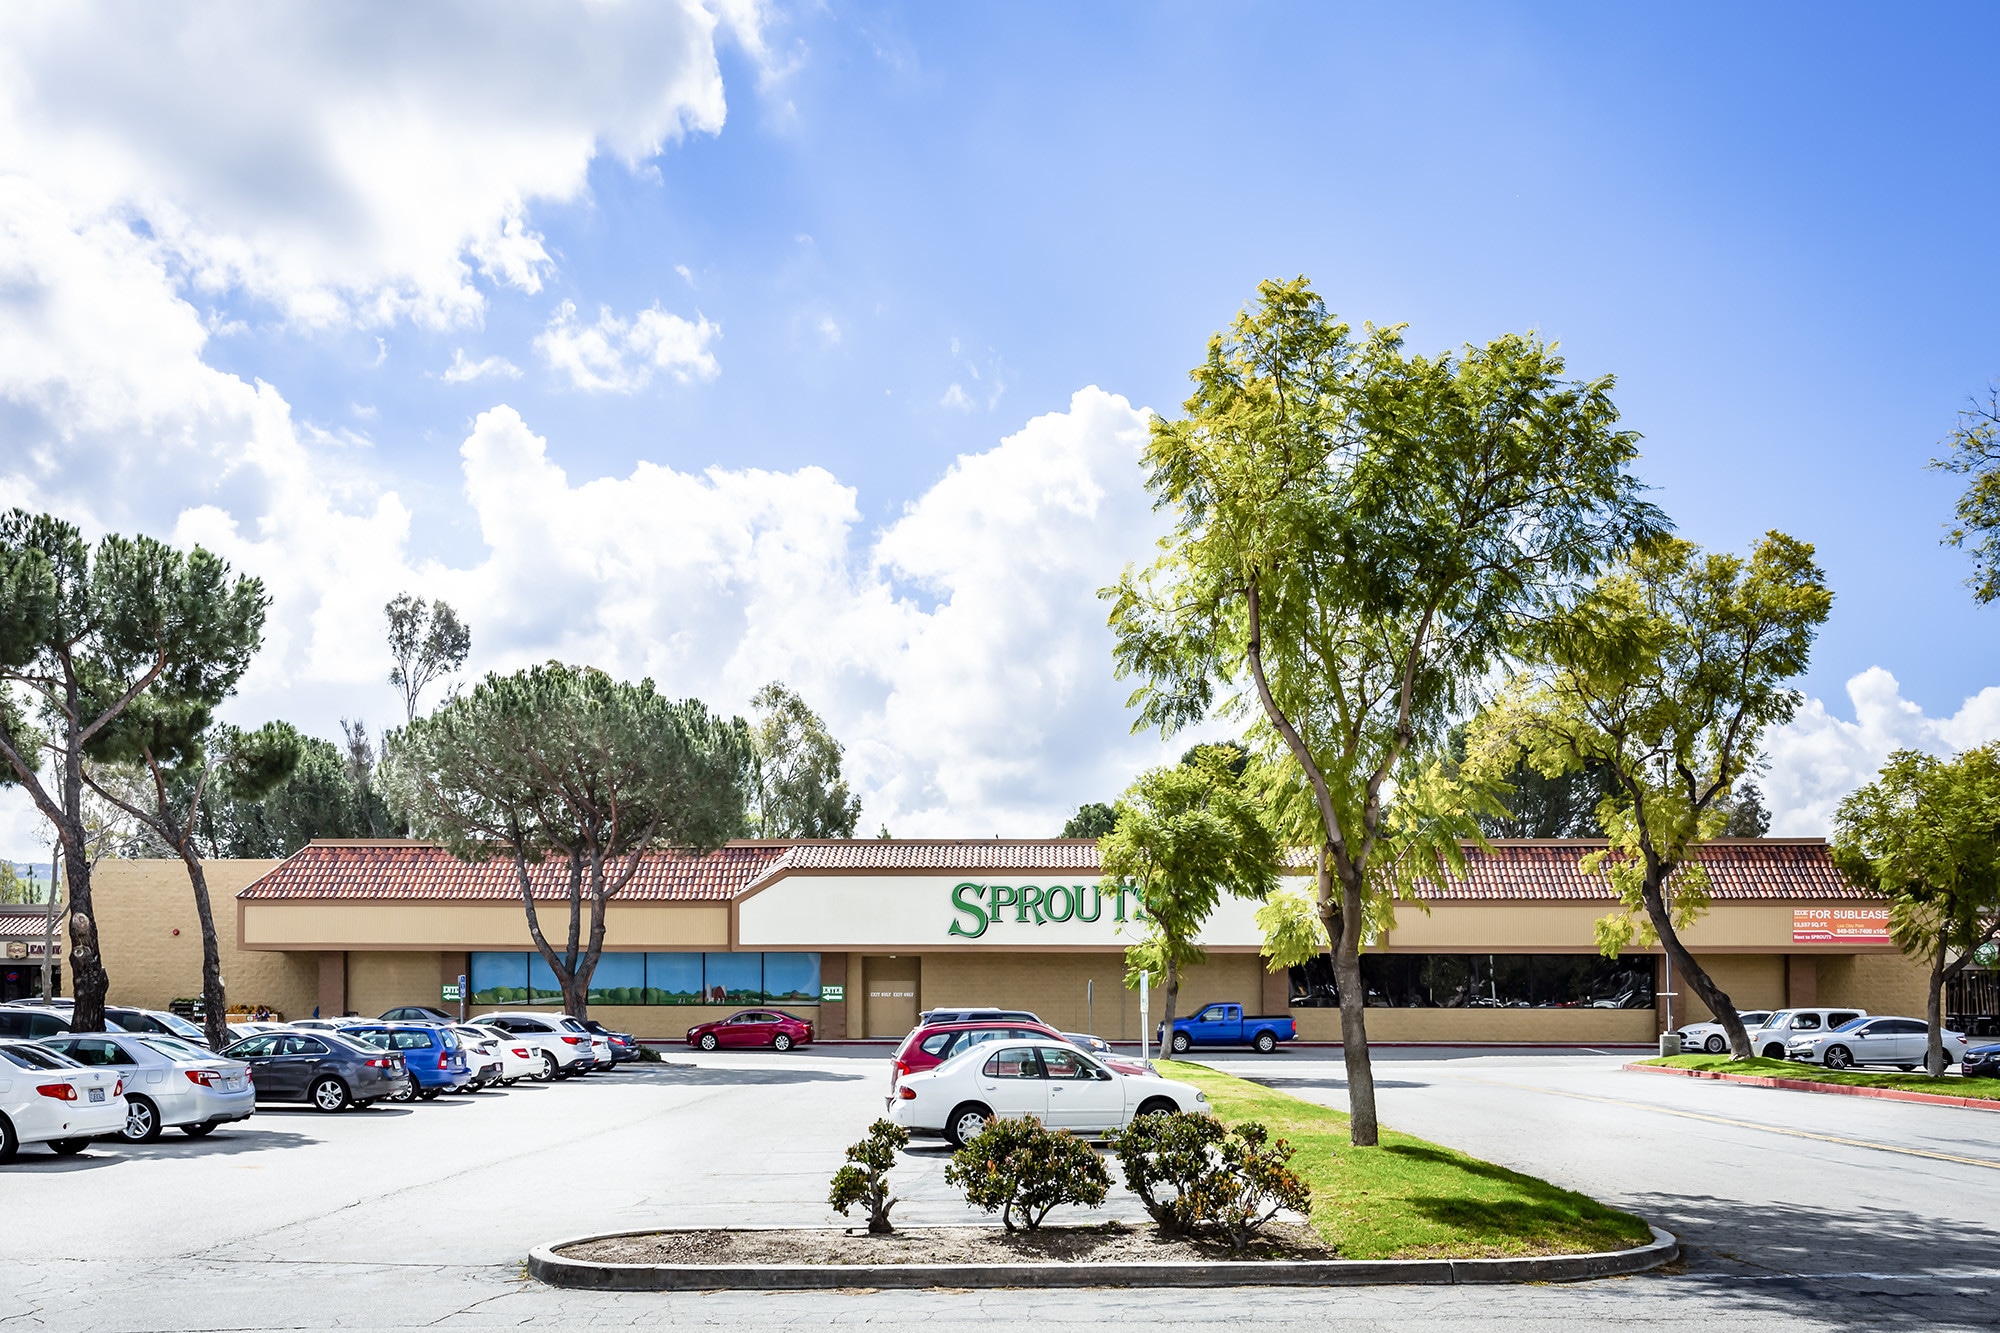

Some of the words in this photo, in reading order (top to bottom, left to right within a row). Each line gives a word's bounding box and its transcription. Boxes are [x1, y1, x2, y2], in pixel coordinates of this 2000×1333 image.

[1809, 910, 1831, 919] FOR
[1833, 910, 1889, 919] SUBLEASE
[822, 986, 843, 994] ENTER
